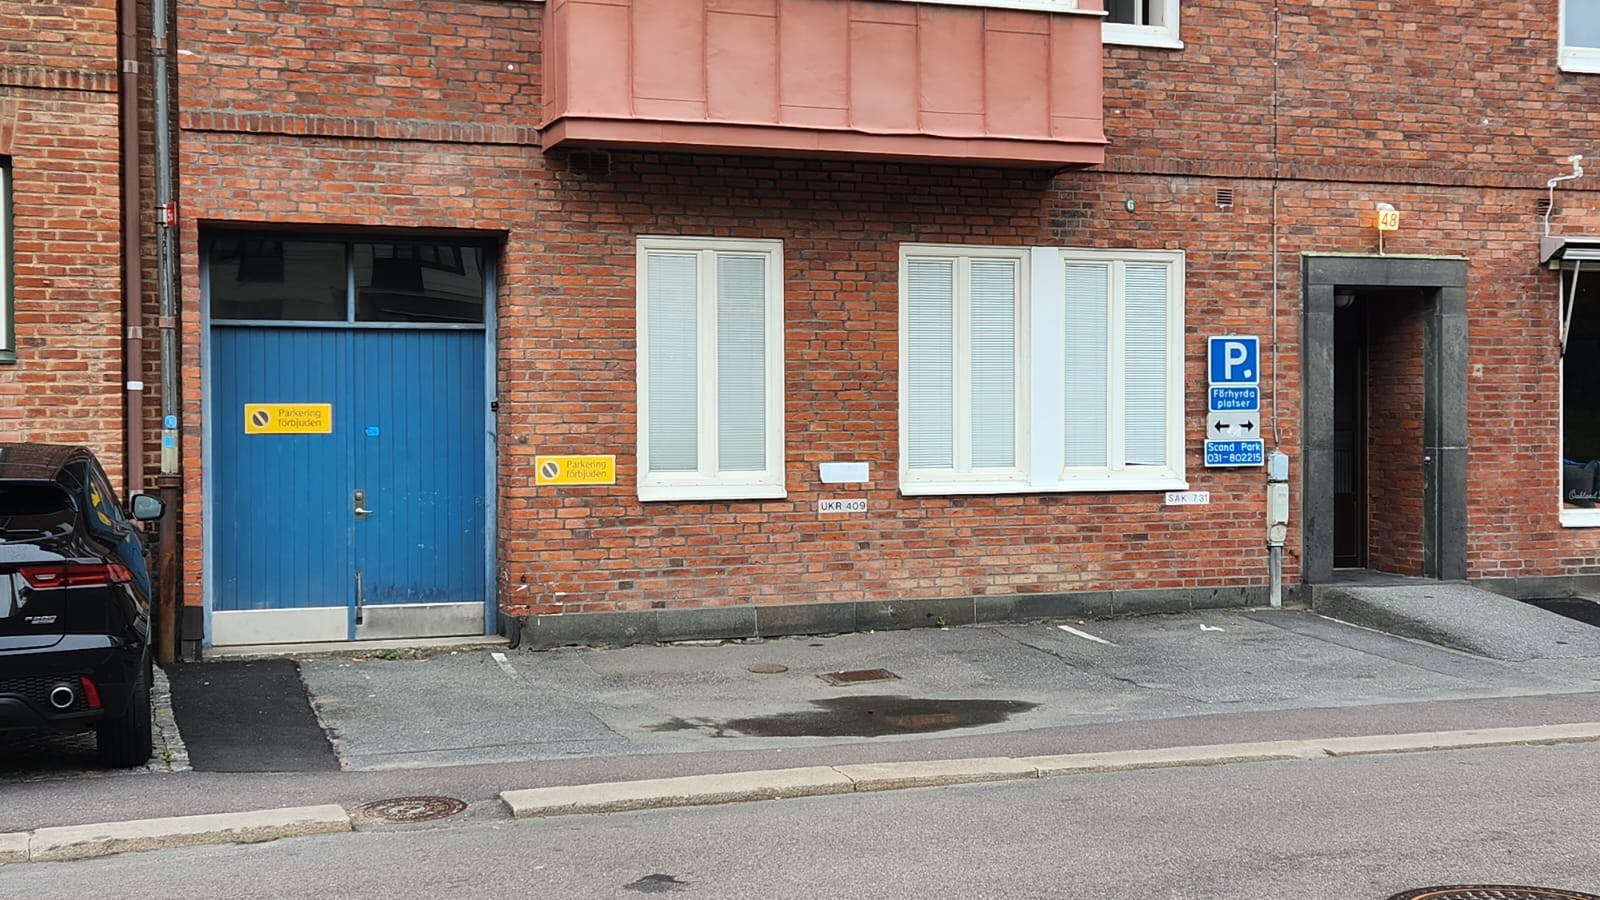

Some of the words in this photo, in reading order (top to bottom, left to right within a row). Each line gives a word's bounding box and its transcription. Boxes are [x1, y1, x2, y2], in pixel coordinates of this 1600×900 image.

[1381, 213, 1397, 228] 48
[1213, 389, 1255, 399] Förhyrda
[1217, 400, 1251, 409] platser
[278, 409, 321, 418] Parkering
[278, 418, 322, 428] förbjuden
[1208, 443, 1235, 452] Scand
[1241, 443, 1261, 452] Park
[1207, 453, 1261, 463] 031-802215
[566, 460, 606, 469] Parkering
[566, 469, 607, 479] förbjuden
[1168, 494, 1188, 503] SAK
[1192, 494, 1208, 503] 731
[821, 501, 842, 511] UKR
[846, 501, 866, 510] 409
